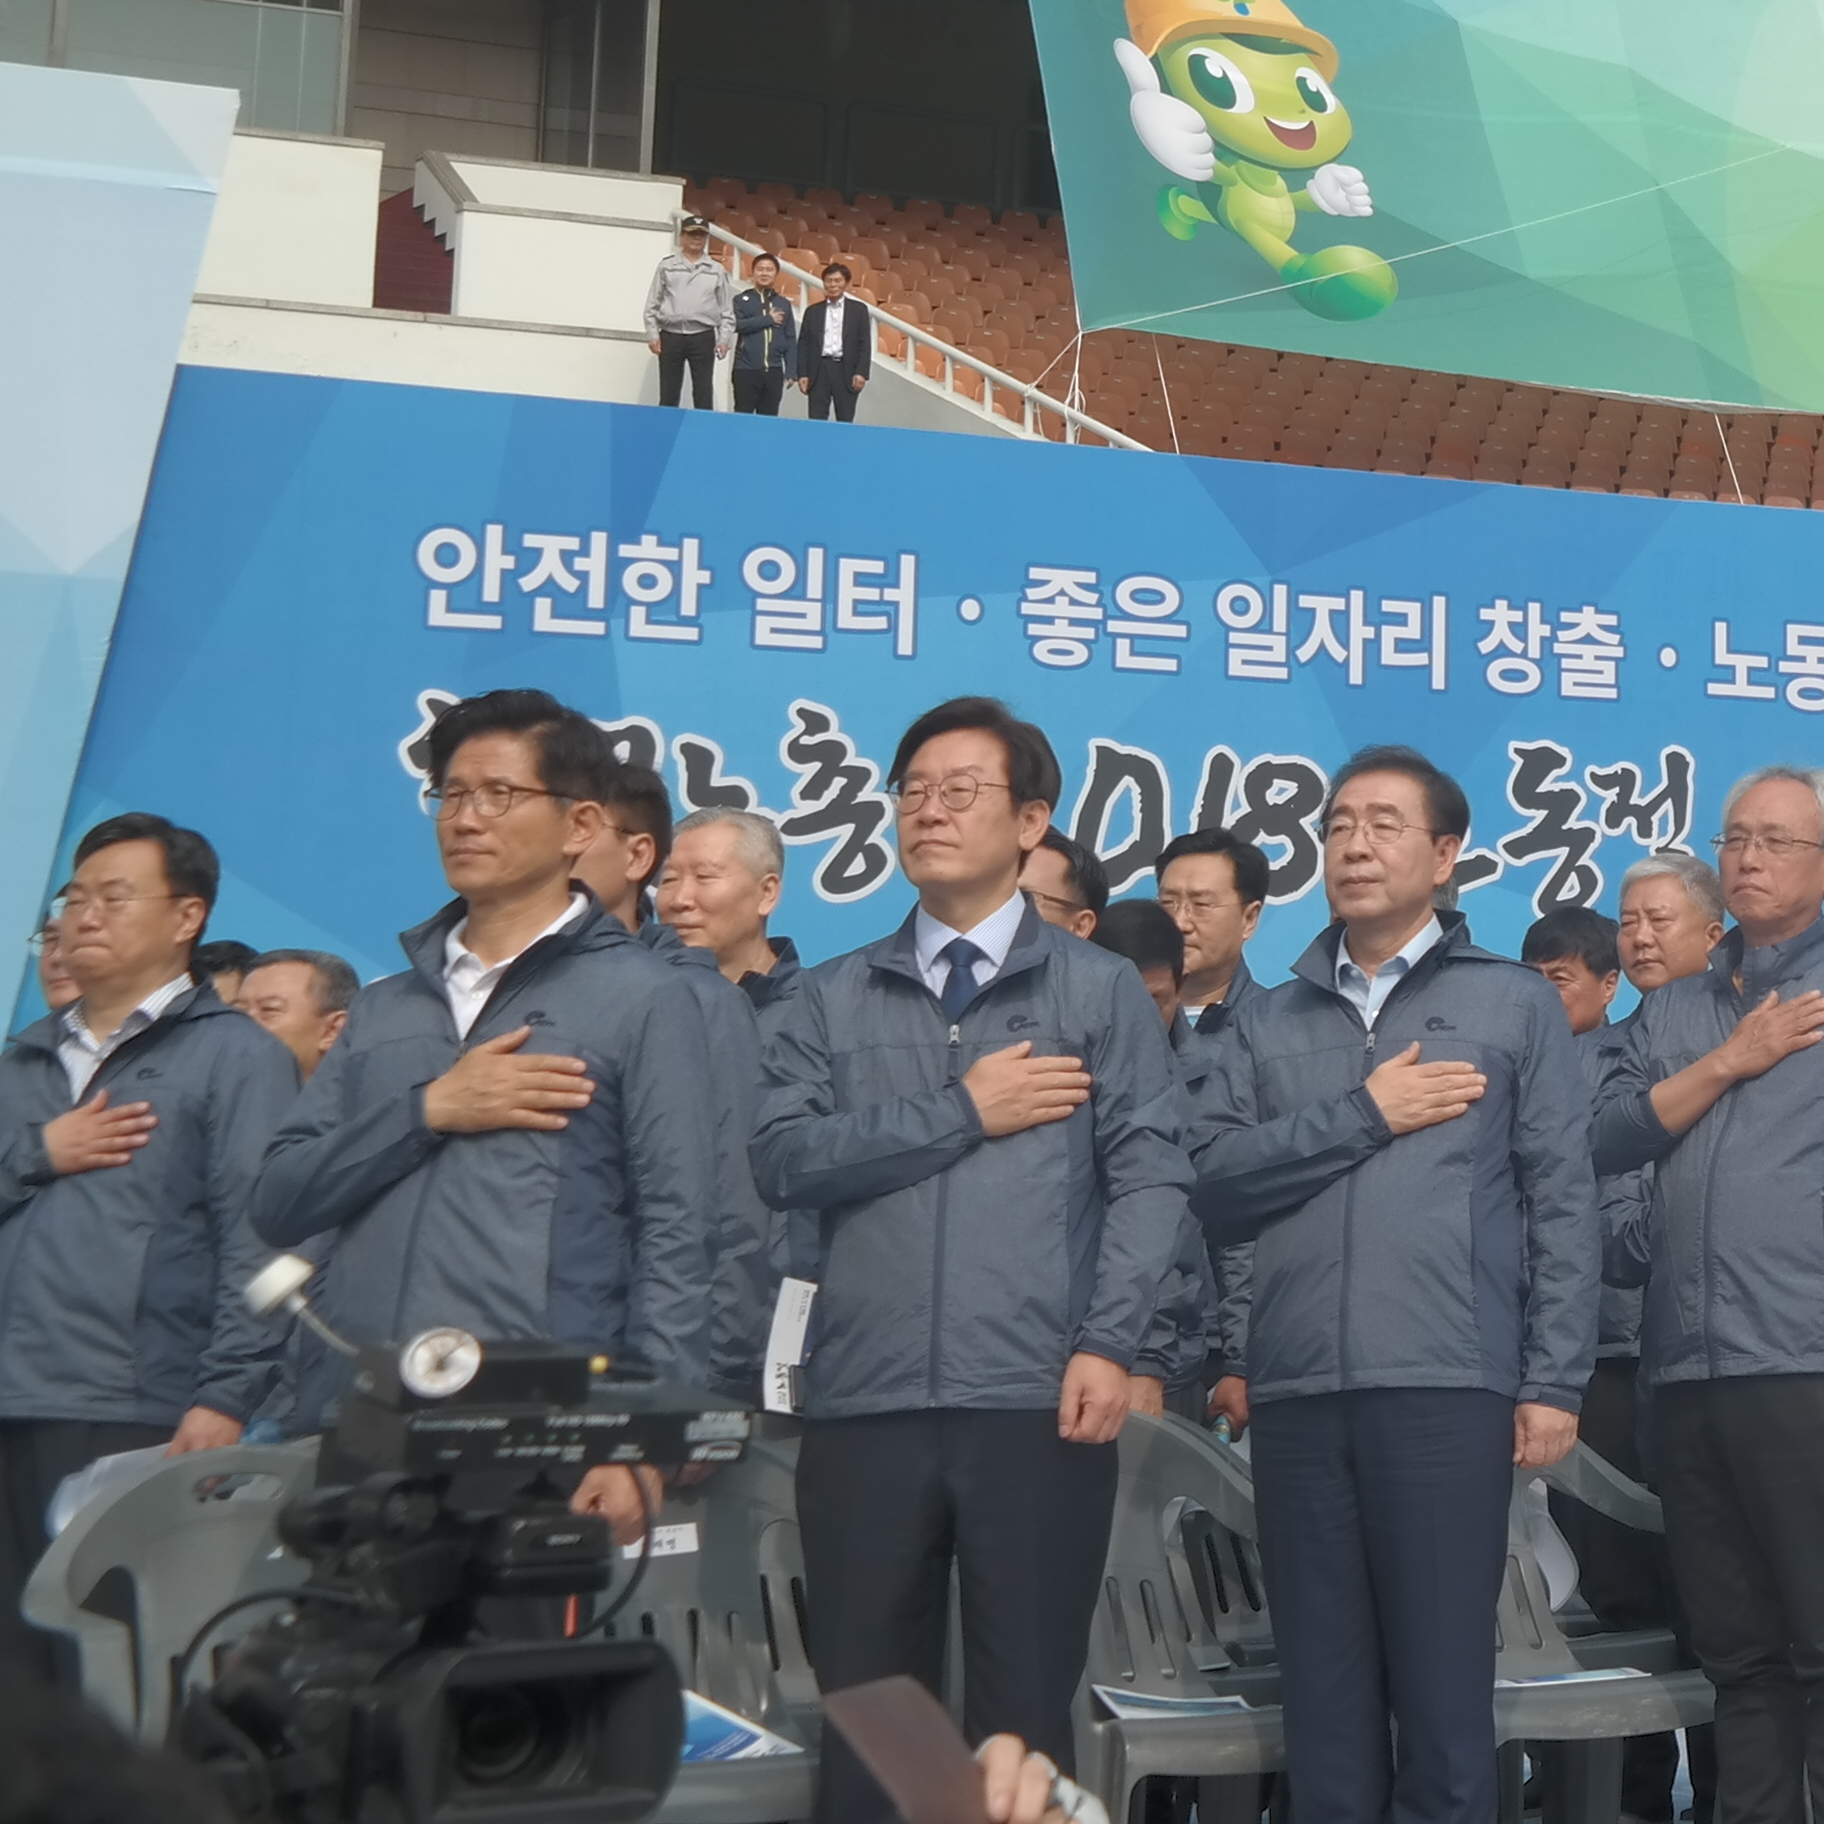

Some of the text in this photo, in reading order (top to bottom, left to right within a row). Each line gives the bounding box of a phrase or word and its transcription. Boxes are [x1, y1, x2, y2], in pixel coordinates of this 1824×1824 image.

[415, 523, 711, 644] 안전한
[740, 545, 918, 659] 일터
[1018, 564, 1189, 673] 좋은
[1213, 580, 1448, 692] 일자리
[1475, 596, 1625, 701] 창출
